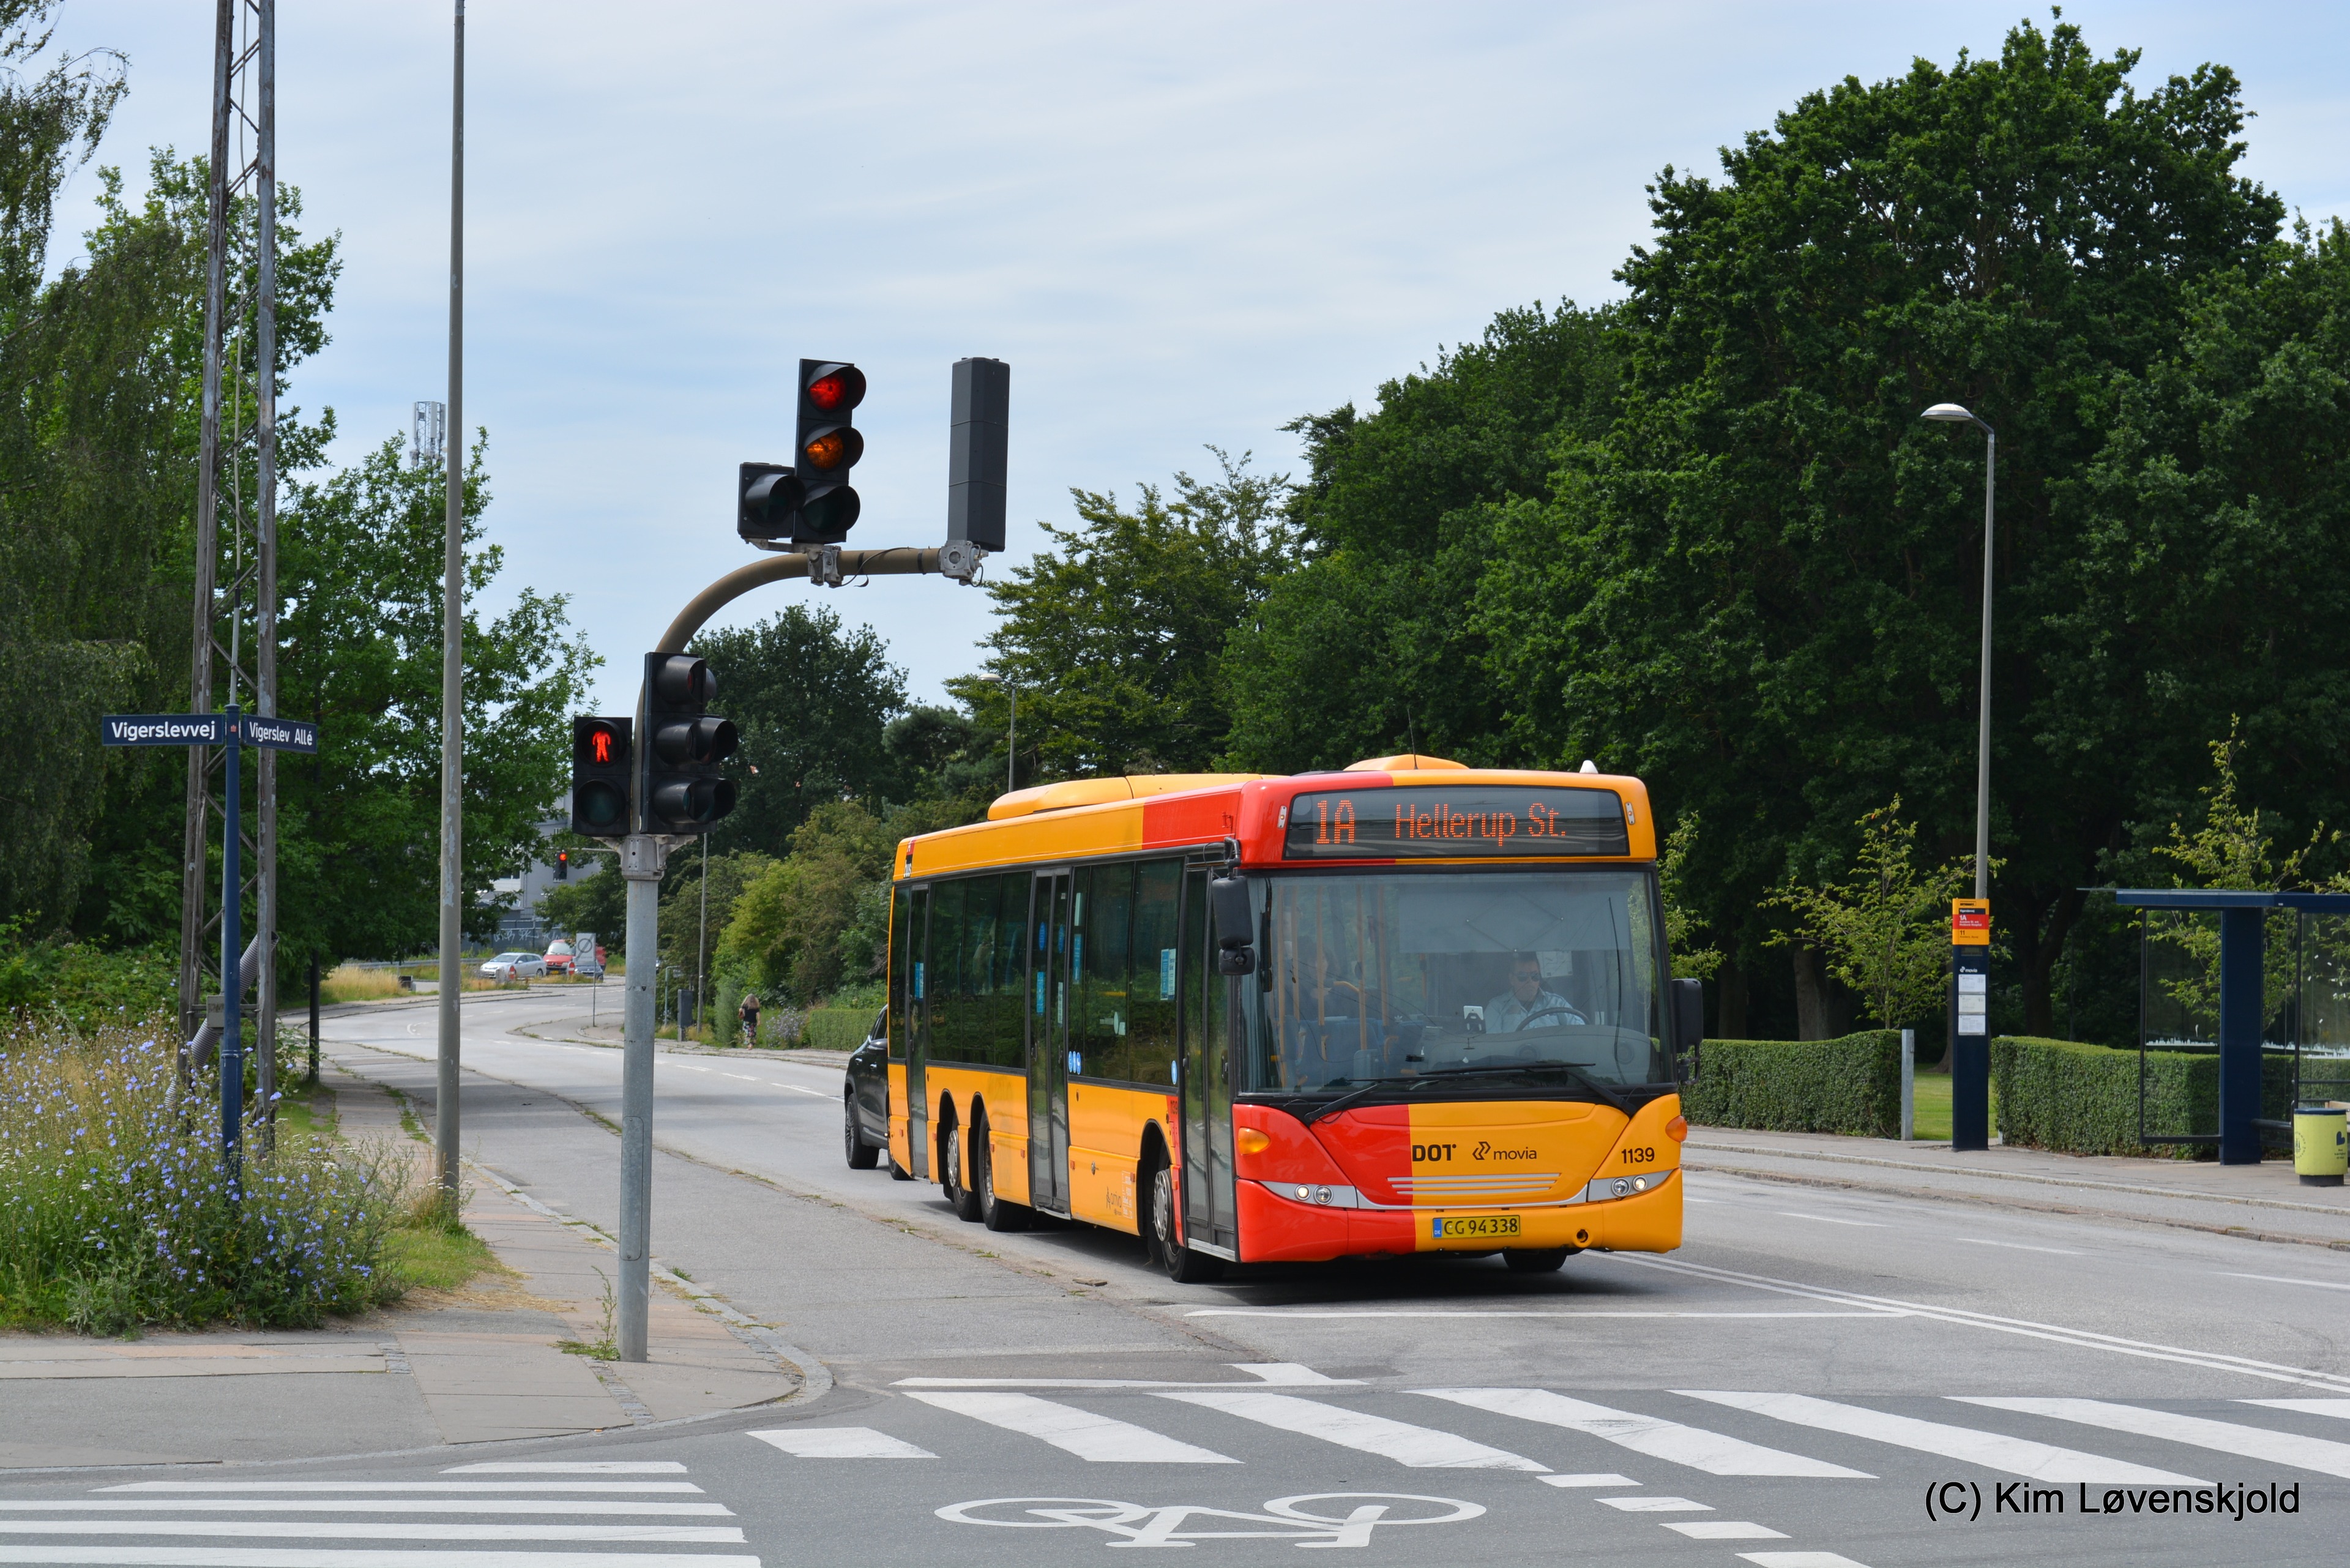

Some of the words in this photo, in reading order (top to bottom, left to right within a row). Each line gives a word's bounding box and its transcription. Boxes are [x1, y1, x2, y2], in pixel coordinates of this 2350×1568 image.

[111, 721, 215, 741] Vigerslevvej
[249, 722, 289, 742] Vigerslev
[294, 728, 313, 745] Allé
[1316, 800, 1355, 844] 1A
[1395, 804, 1516, 846] Hellerup
[1528, 802, 1566, 837] St.
[1412, 1144, 1457, 1162] DOT
[1493, 1146, 1537, 1160] movia
[1621, 1148, 1655, 1163] 1139
